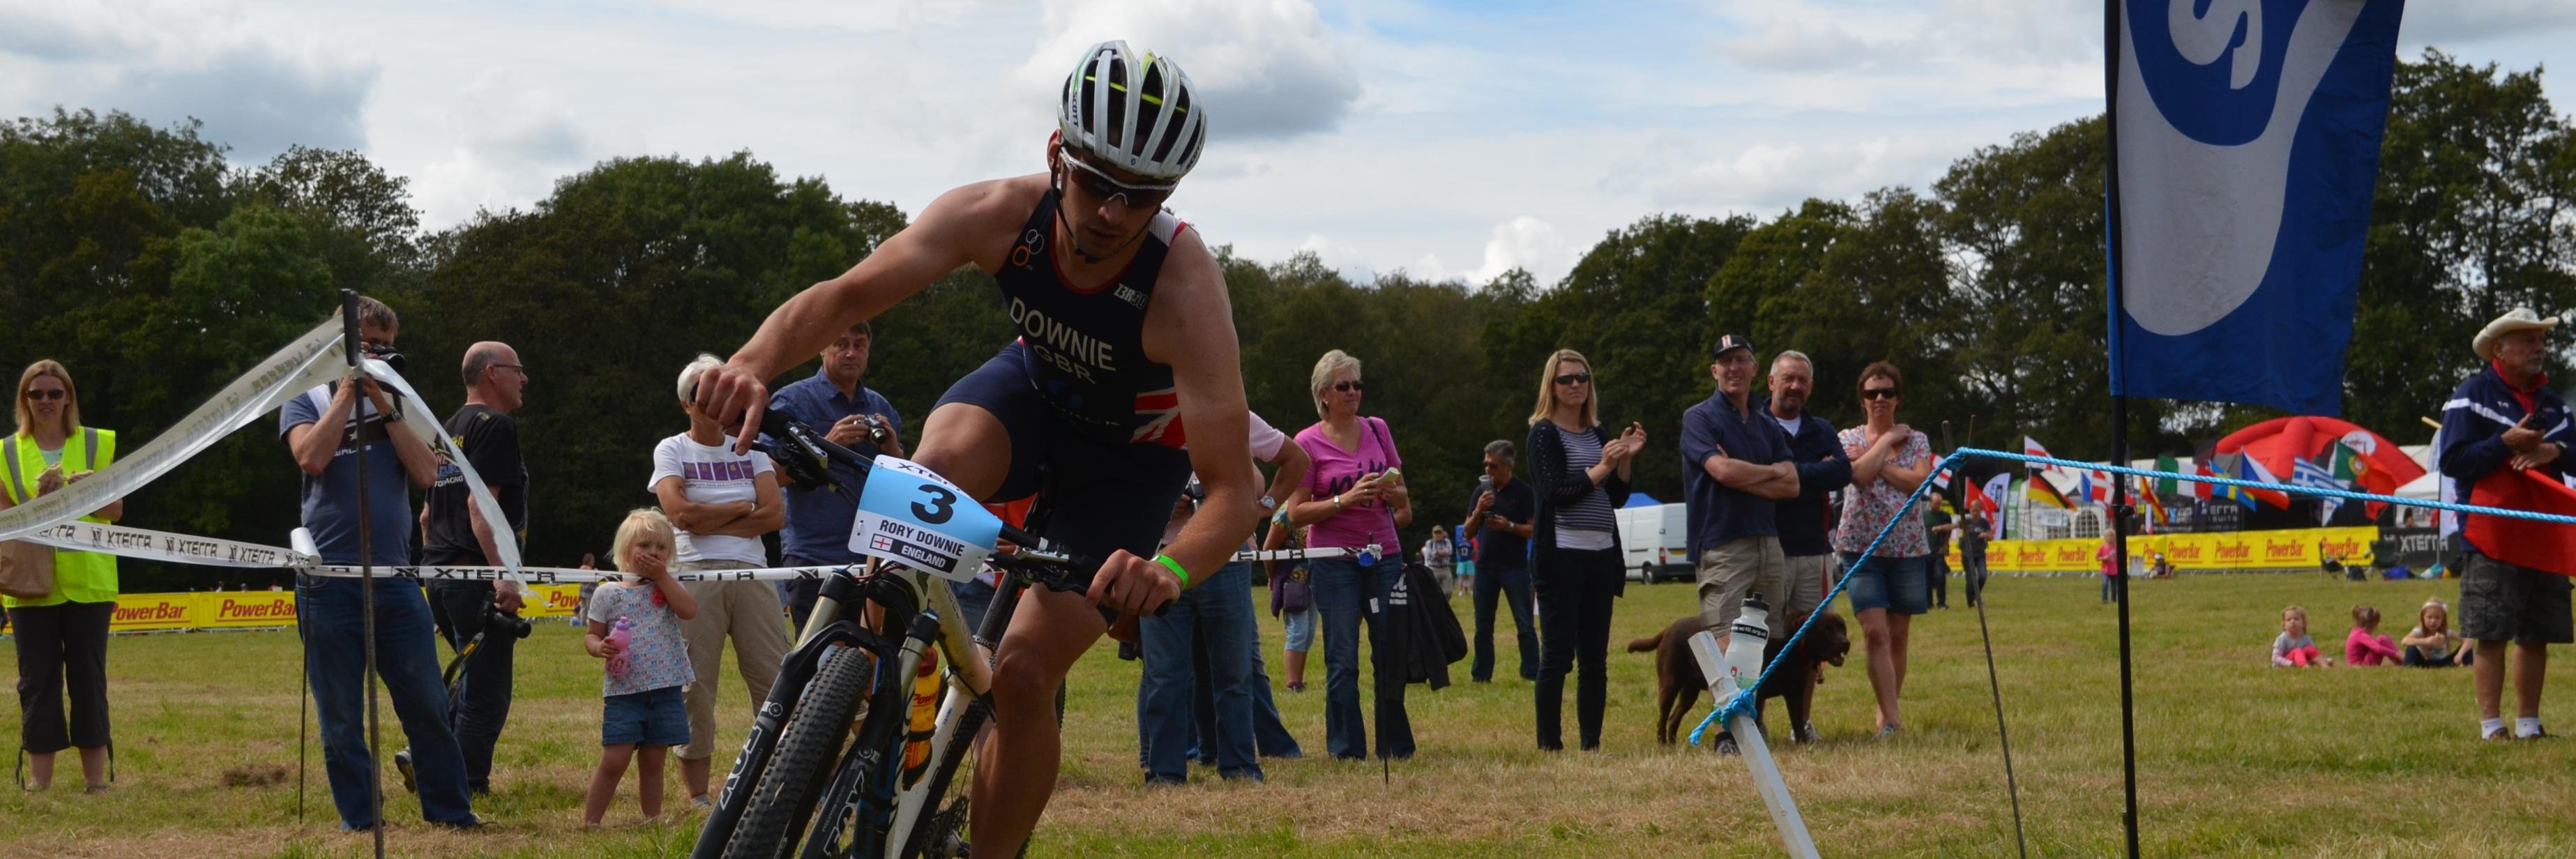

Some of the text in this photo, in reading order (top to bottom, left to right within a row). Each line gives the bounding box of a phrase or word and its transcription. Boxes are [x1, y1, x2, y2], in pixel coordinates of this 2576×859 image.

[1010, 296, 1116, 371] DOWNIE
[1033, 344, 1097, 384] GBR
[911, 484, 957, 524] 3
[107, 530, 151, 549] XTERRA
[879, 519, 965, 556] RORY DOWNIE
[179, 540, 218, 556] XTERRA
[241, 547, 275, 564] XTERRA
[2017, 544, 2046, 562] PowerBar
[2058, 544, 2086, 562] PowerBar
[2168, 541, 2201, 558] PowerBar
[2215, 540, 2250, 558] PowerBar
[2266, 538, 2304, 556] PowerBar
[901, 545, 946, 568] ENGLAND
